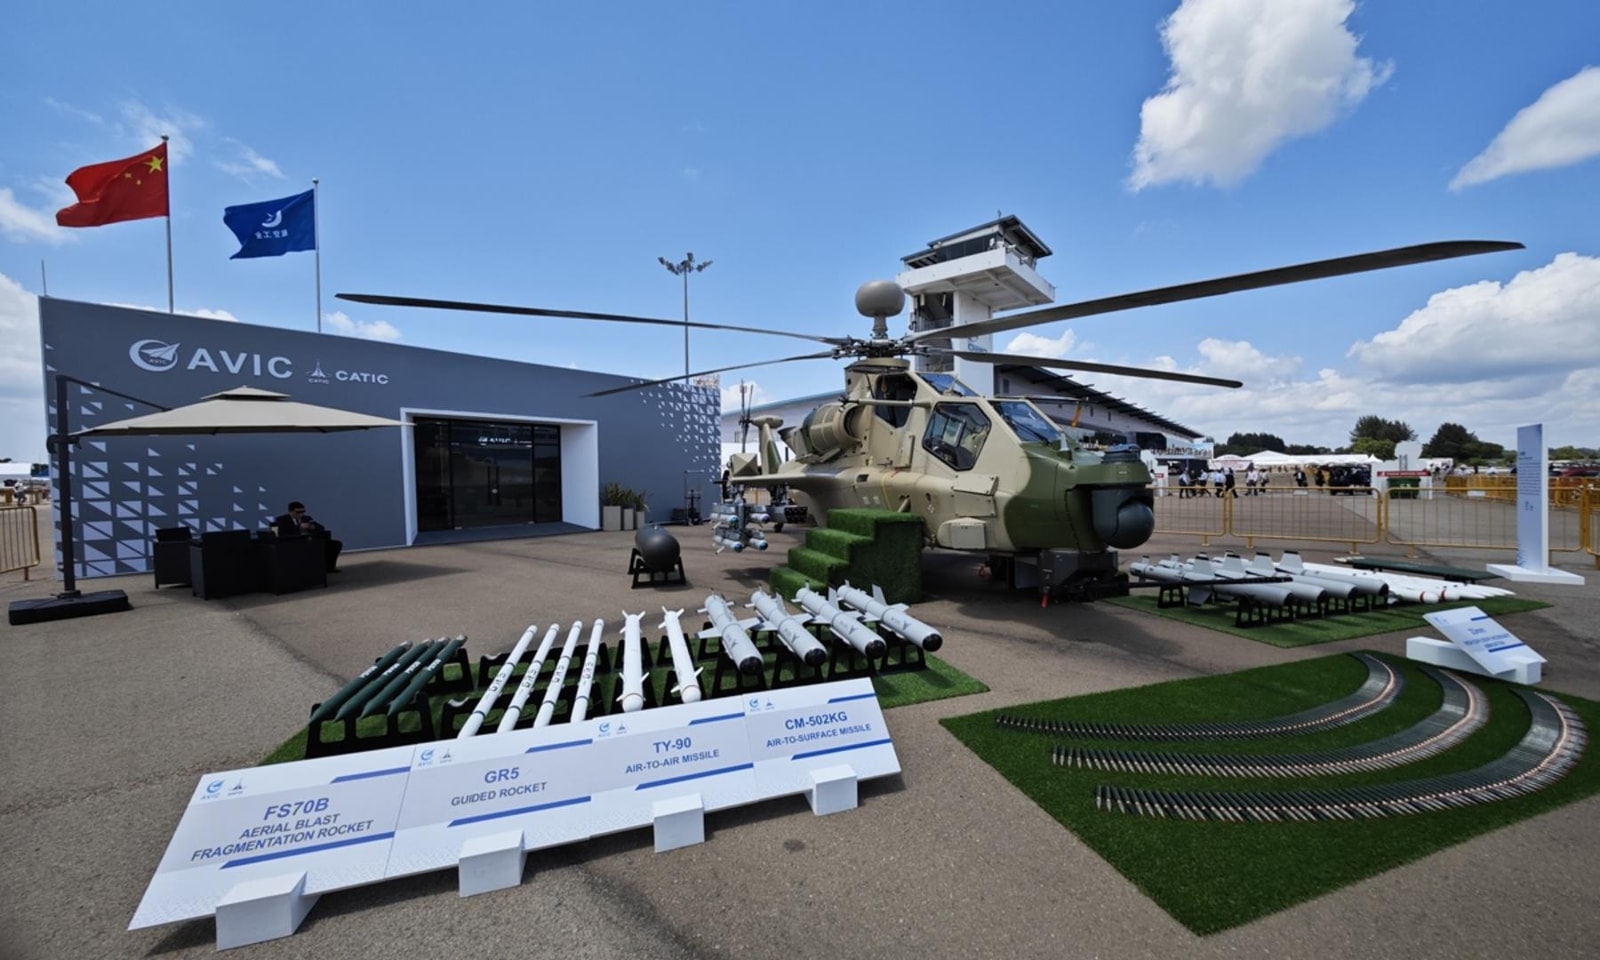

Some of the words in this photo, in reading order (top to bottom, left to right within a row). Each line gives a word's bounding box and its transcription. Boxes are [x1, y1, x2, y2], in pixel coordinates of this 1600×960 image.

[187, 347, 293, 378] AVIC
[335, 370, 389, 385] CATIC
[785, 711, 848, 730] CM-502KG
[653, 737, 692, 753] TY-90
[766, 729, 838, 748] AIR-TO-SURFACE
[839, 723, 872, 735] MISSILE
[625, 756, 680, 774] AIR-TO-AIR
[682, 749, 720, 763] MISSILE
[484, 767, 520, 784] GR5
[451, 790, 496, 806] GUIDED
[499, 782, 547, 798] ROCKET
[264, 797, 329, 820] FS70B
[239, 822, 291, 840] AERIAL
[294, 813, 341, 830] BLAST
[191, 830, 315, 861] FRAGMENTATION
[317, 819, 374, 838] ROCKET
